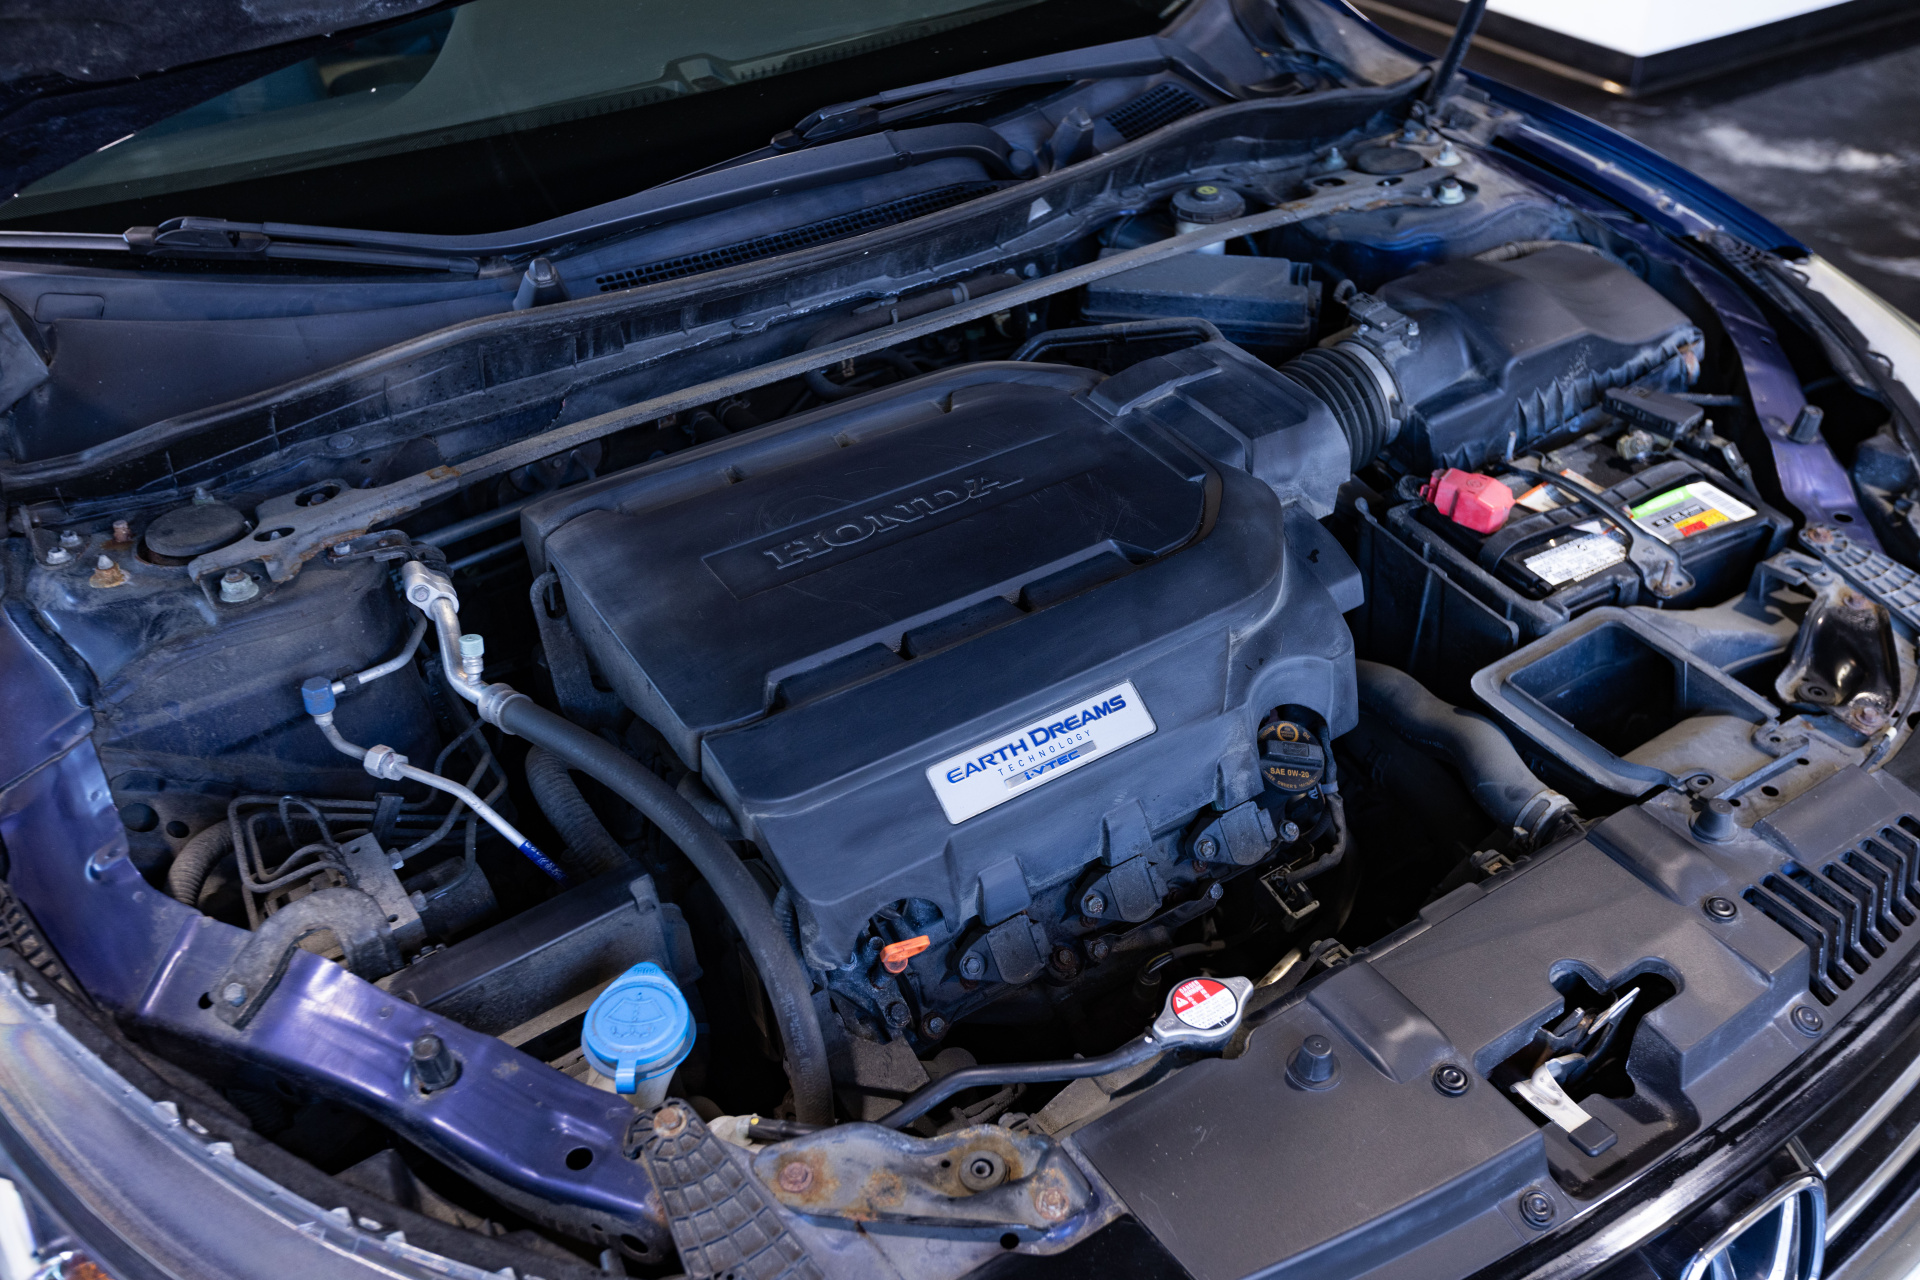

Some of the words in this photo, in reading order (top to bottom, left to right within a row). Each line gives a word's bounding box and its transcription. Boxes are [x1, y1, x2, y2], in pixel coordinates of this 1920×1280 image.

[763, 476, 1024, 570] HONDA
[946, 738, 1030, 784] EARTH
[1028, 694, 1127, 748] DREAMS
[997, 729, 1092, 777] TECHNOLOGY
[1270, 767, 1286, 776] SAE
[1287, 769, 1310, 779] 0W-20
